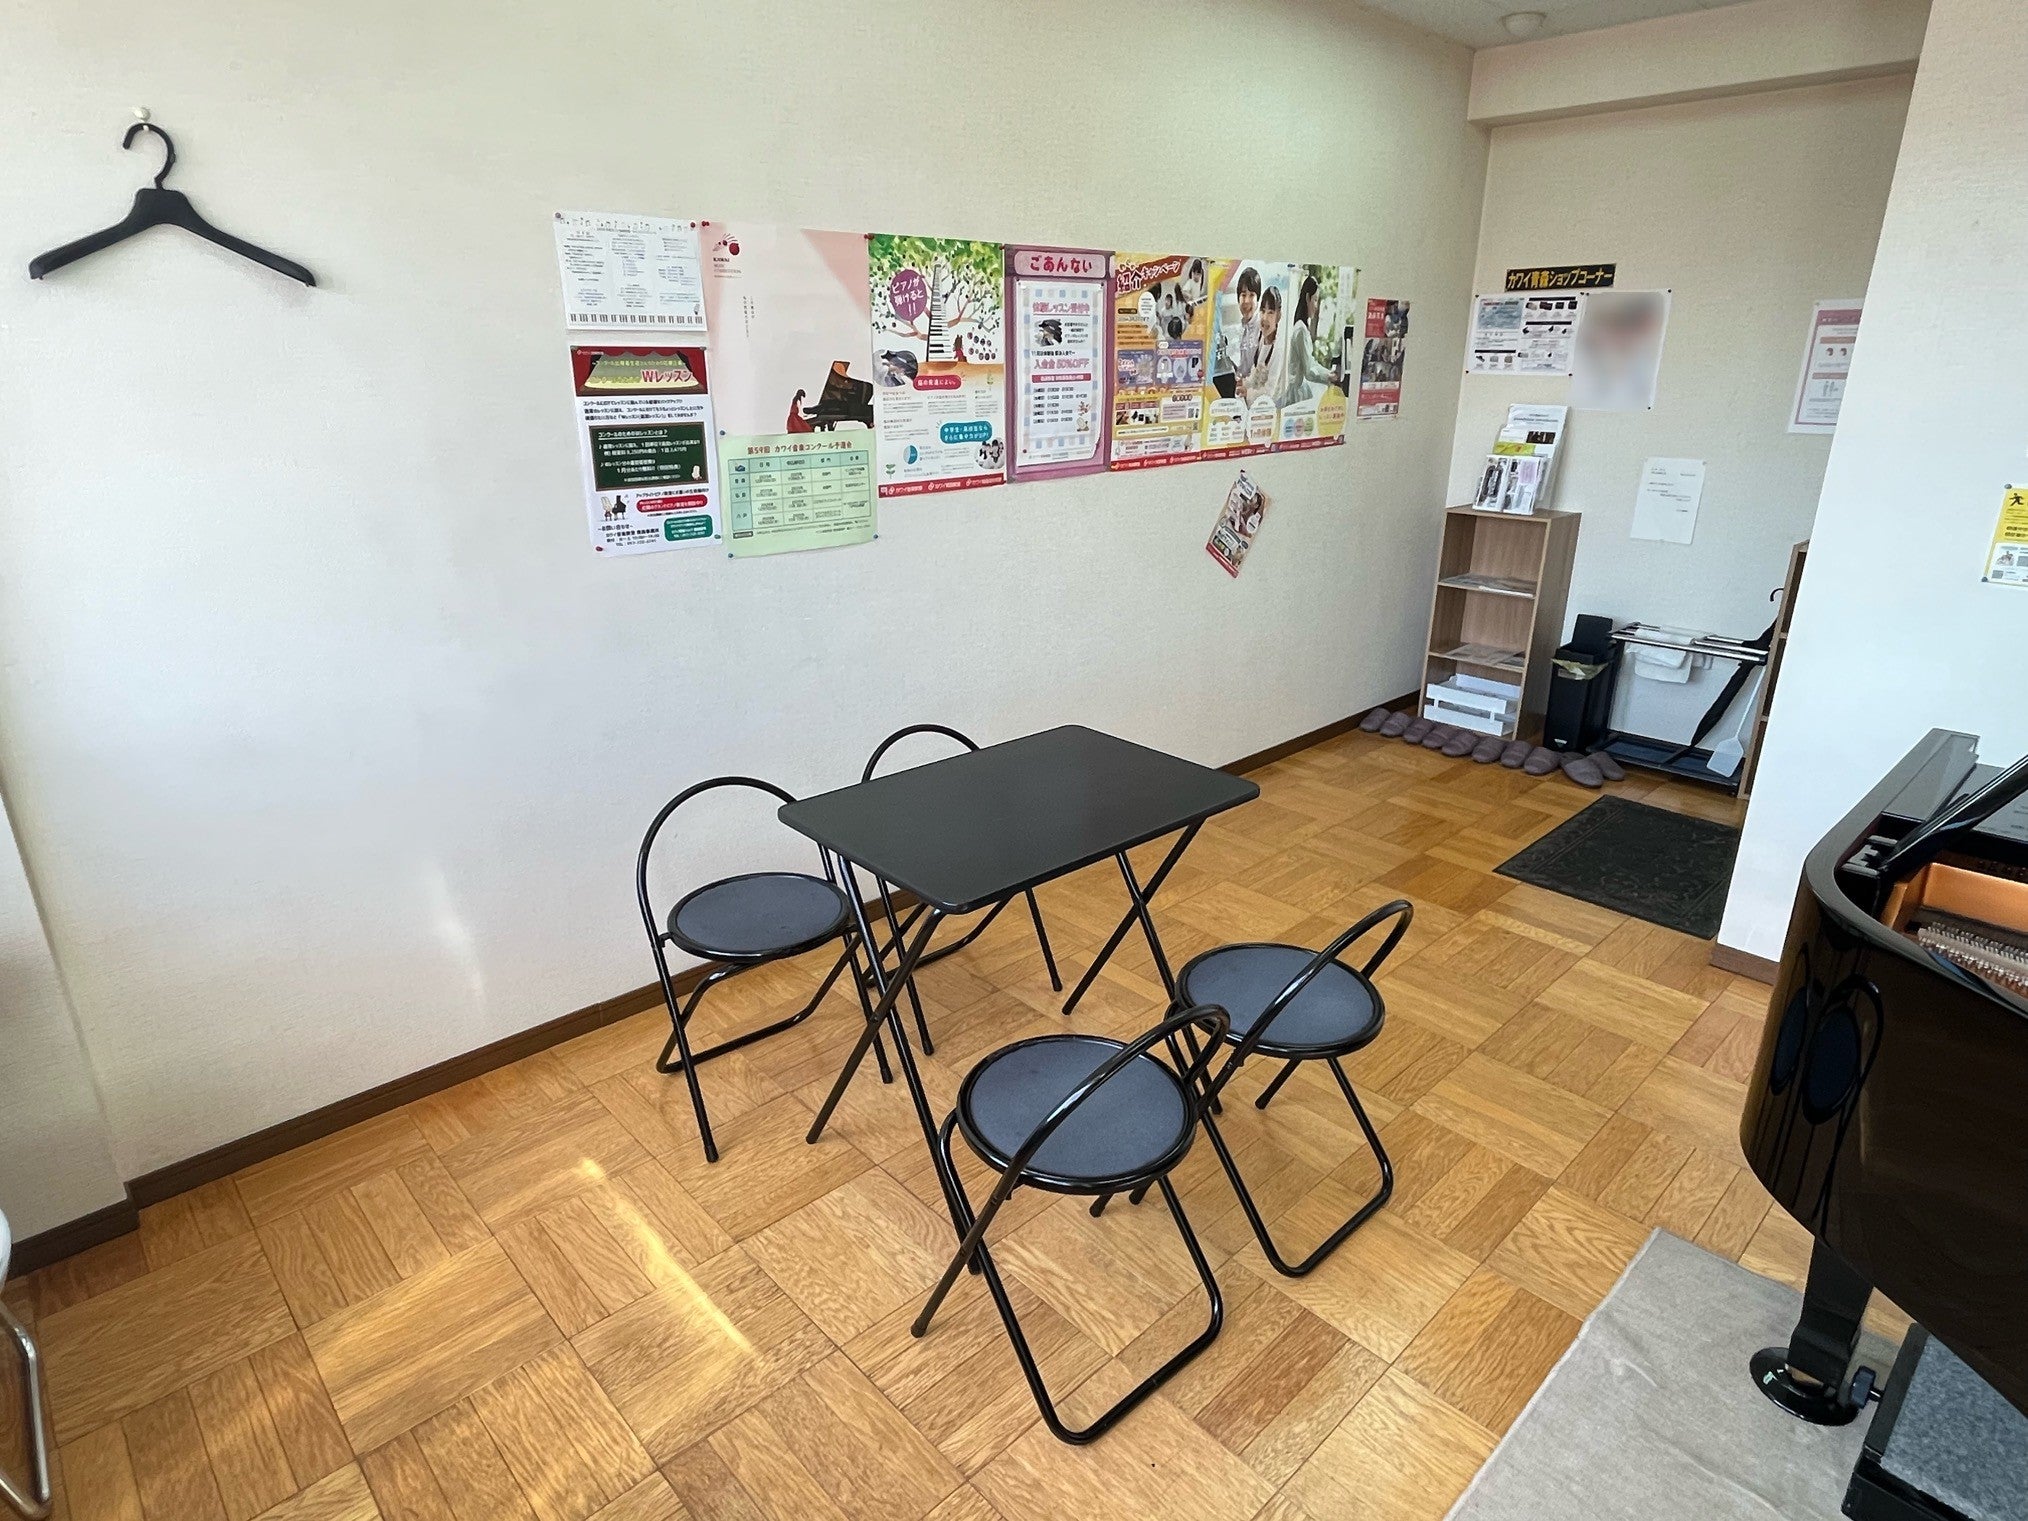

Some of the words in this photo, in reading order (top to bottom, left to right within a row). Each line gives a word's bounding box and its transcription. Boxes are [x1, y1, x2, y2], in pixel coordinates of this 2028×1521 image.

[1030, 255, 1092, 273] ごあんない
[891, 276, 920, 294] ピアノが
[641, 369, 693, 383] Wレッスン
